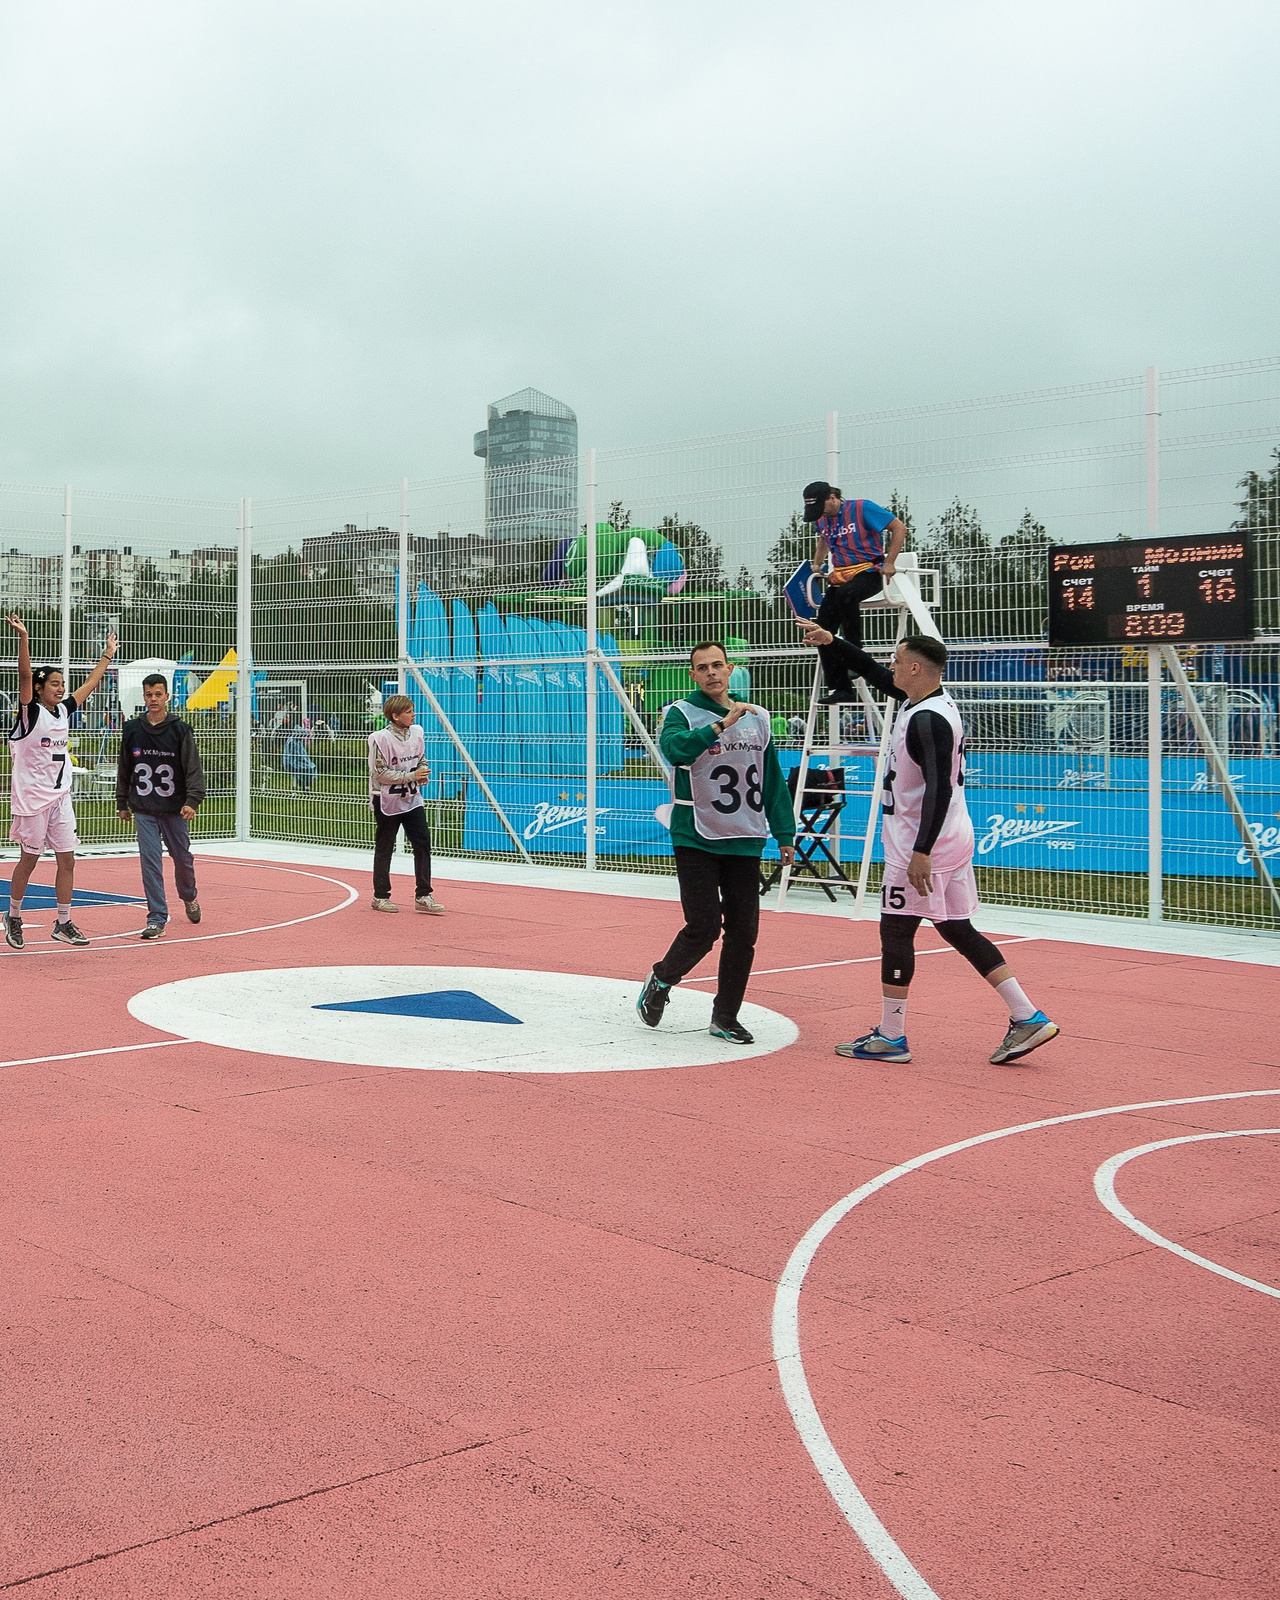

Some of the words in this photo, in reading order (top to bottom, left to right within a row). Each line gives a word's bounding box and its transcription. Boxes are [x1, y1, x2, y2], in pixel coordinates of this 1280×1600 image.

[1131, 565, 1160, 574] ТАЙМ
[1137, 573, 1150, 597] 1
[1199, 577, 1236, 603] 16
[1062, 586, 1095, 610] 14
[1126, 603, 1164, 612] ВРЕМЯ
[1125, 612, 1184, 637] 8:09
[724, 742, 738, 751] VK
[51, 754, 66, 790] 7
[134, 762, 175, 798] 33
[709, 763, 764, 815] 38
[523, 802, 612, 840] Зени
[582, 825, 607, 835] 125
[977, 814, 1082, 855] Зенит
[1046, 840, 1076, 850] 1925
[881, 884, 907, 910] 15
